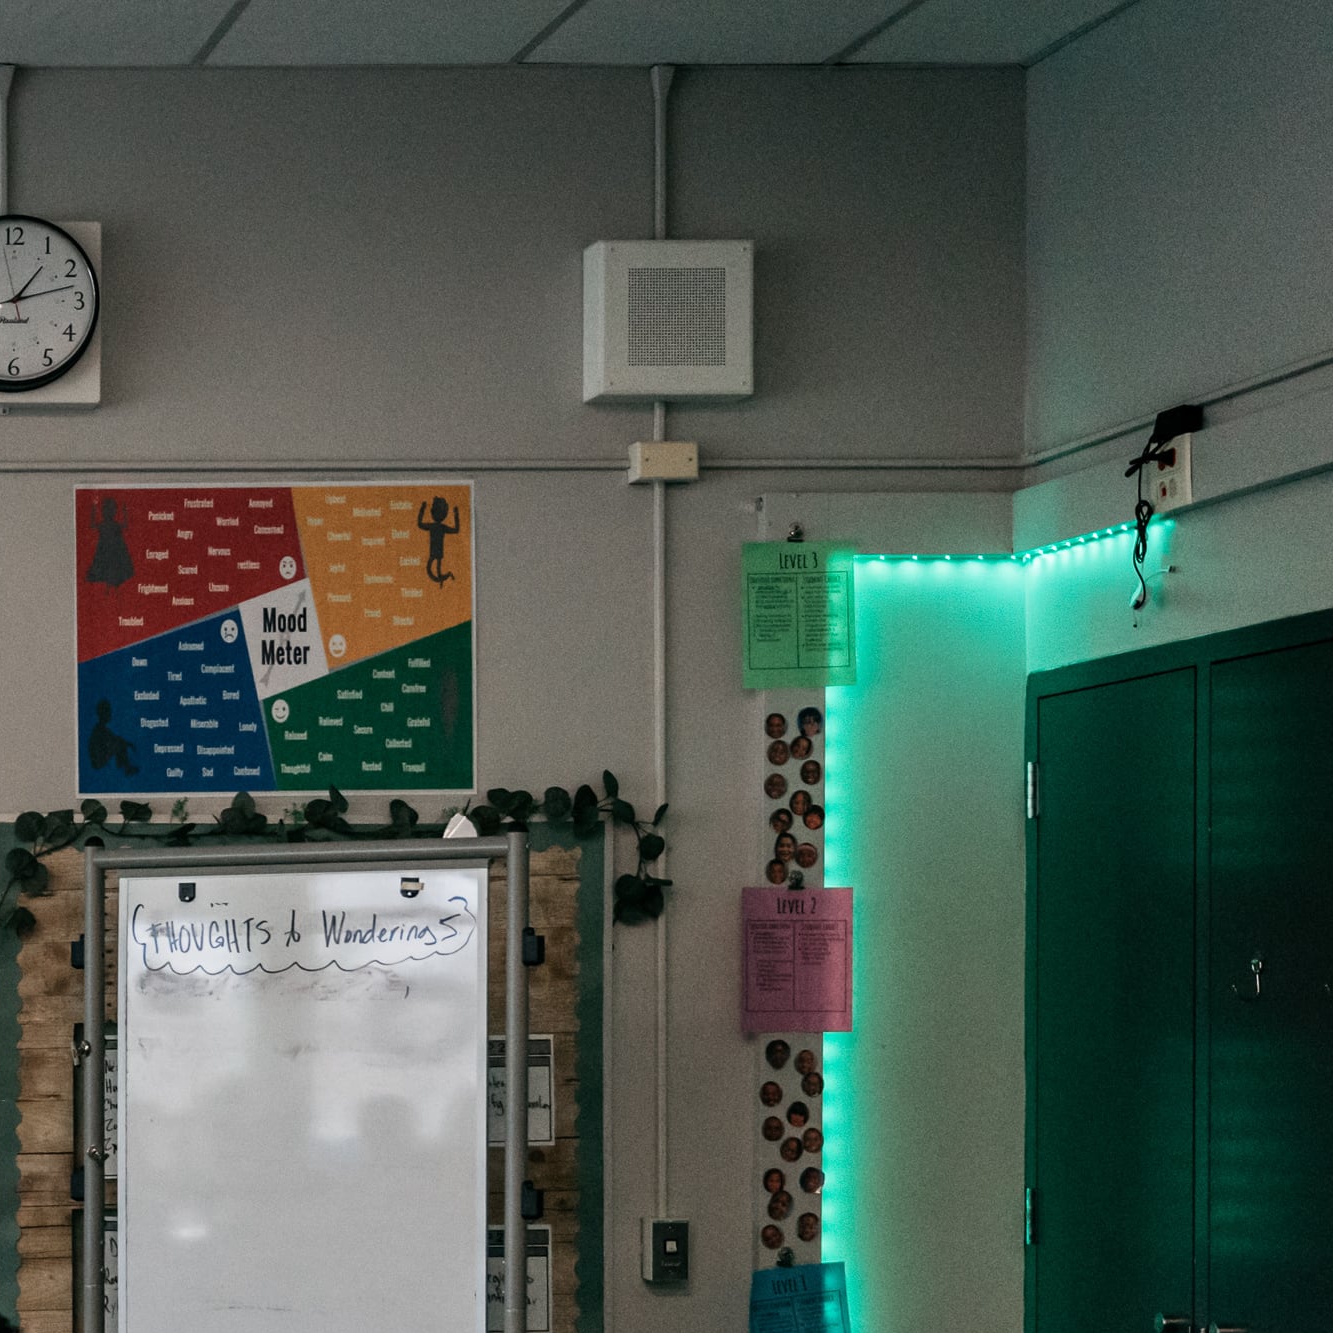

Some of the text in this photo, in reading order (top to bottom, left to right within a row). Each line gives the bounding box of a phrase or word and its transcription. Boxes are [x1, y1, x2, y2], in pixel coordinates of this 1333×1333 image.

[6, 227, 24, 245] 12
[45, 236, 51, 254] 1
[65, 259, 77, 277] 2
[74, 292, 84, 310] 3
[63, 324, 76, 341] 4
[43, 349, 53, 366] 5
[8, 358, 19, 376] 6
[779, 552, 817, 569] LEVEL 3
[262, 606, 309, 634] Mood
[260, 639, 311, 666] Meter
[776, 896, 817, 915] LEVEL 2
